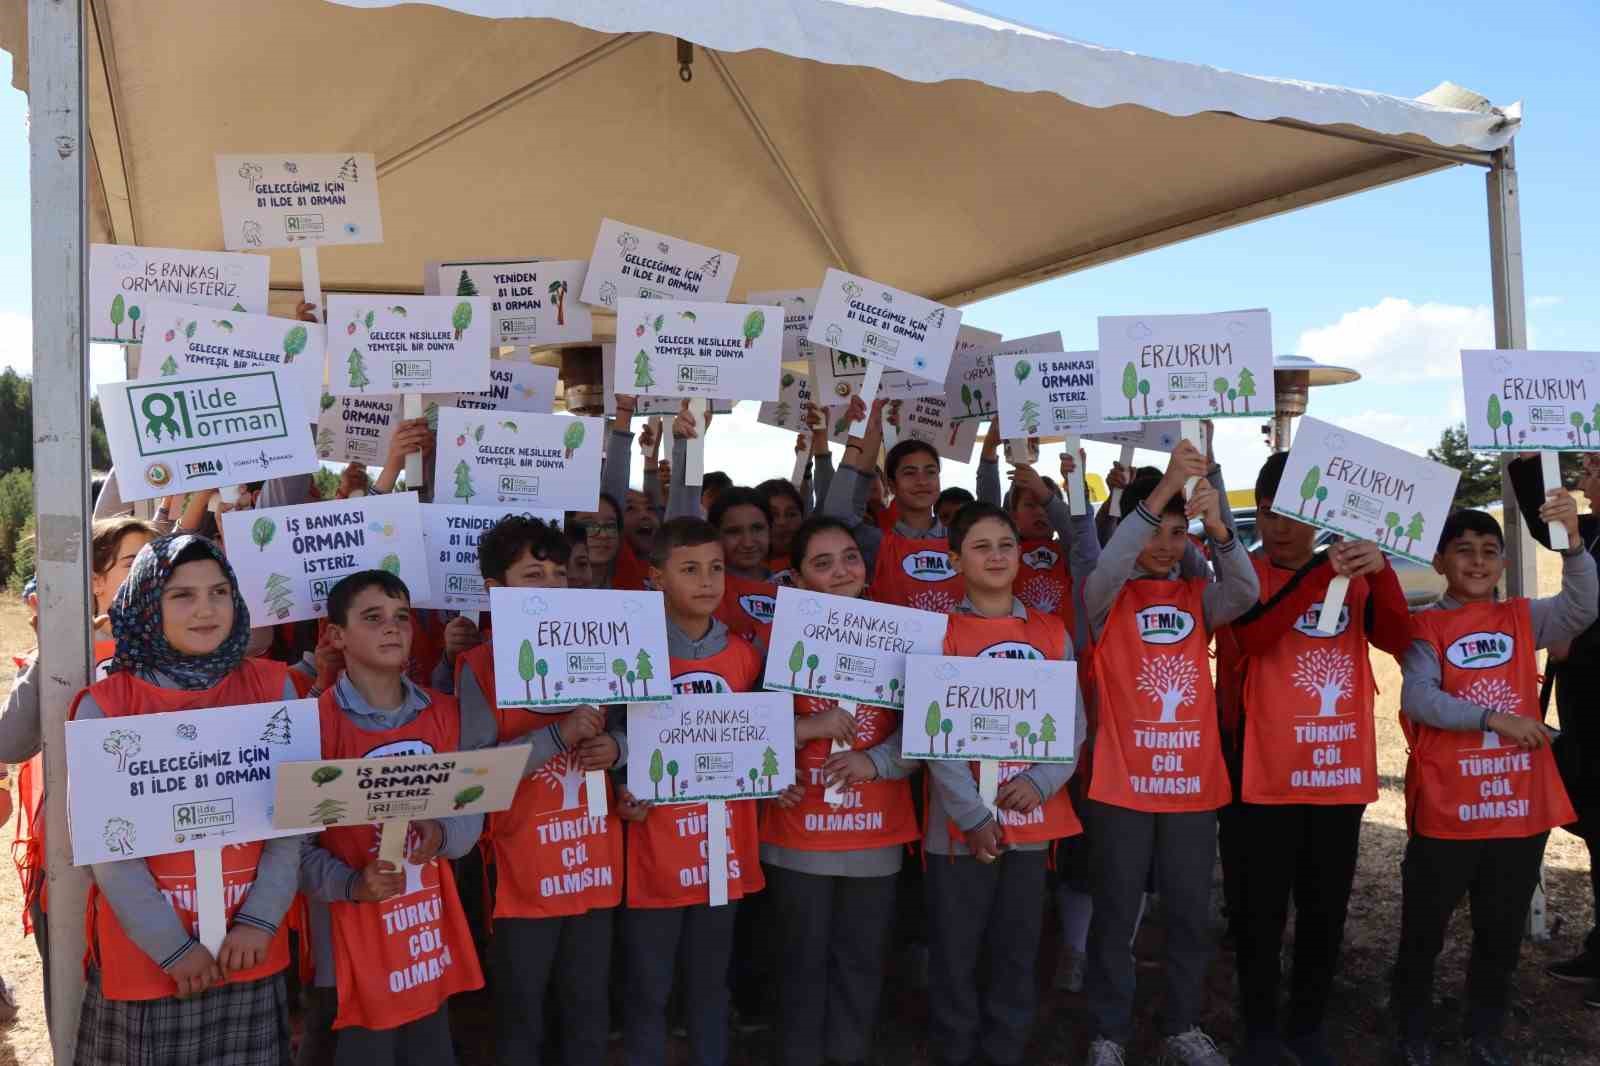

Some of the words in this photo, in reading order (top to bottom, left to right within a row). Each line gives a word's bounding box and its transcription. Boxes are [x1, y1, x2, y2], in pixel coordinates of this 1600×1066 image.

[257, 197, 267, 208] 81
[297, 196, 307, 206] 81
[310, 195, 346, 206] ORMAN
[161, 262, 219, 280] BANKASI
[621, 264, 631, 275] 81
[656, 274, 665, 284] 81
[667, 278, 700, 293] ORMAN
[121, 277, 183, 294] ORMANI
[498, 287, 508, 298] 81
[492, 302, 502, 311] 81
[505, 299, 542, 311] ORMAN
[847, 309, 856, 319] 81
[881, 321, 890, 331] 81
[893, 325, 925, 342] ORMAN
[369, 331, 406, 340] GELECEK
[657, 335, 695, 345] GELECEK
[188, 342, 229, 356] GELECEK
[1141, 342, 1233, 369] ERZURUM
[1051, 360, 1095, 372] BANKASI
[1041, 373, 1094, 389] ORMANI
[1503, 377, 1587, 401] ERZURUM
[190, 388, 237, 411] ilde
[354, 399, 393, 411] BANKASI
[197, 413, 278, 437] orman
[342, 409, 390, 426] ORMANI
[478, 445, 516, 456] GELECEK
[185, 460, 215, 475] TEMA
[1326, 456, 1416, 505] ERZURUM
[286, 515, 300, 536] İŞ
[305, 510, 365, 531] BANKASI
[292, 529, 365, 555] ORMANI
[449, 534, 461, 546] 81
[465, 533, 482, 547] İL
[440, 550, 451, 562] 81
[913, 556, 945, 569] TEMA
[747, 599, 776, 614] TEM
[537, 620, 630, 647] ERZURUM
[843, 612, 899, 636] BANKASI
[803, 623, 863, 647] ORMANI
[673, 679, 713, 695] TEMA
[944, 685, 1036, 711] ERZURUM
[696, 709, 750, 726] BANKASI
[659, 727, 717, 745] ORMANI
[1134, 726, 1200, 750] TÜRKİYE
[1294, 722, 1357, 744] TÜRKİYE
[128, 749, 232, 776] GELECEĞİMİZ
[239, 744, 270, 768] İÇİN
[1152, 751, 1184, 775] ÇÖL
[1312, 744, 1342, 767] ÇÖL
[1458, 751, 1532, 777] TÜRKİYE
[381, 760, 456, 776] BANKASI
[1290, 767, 1362, 788] OLMASIN
[130, 780, 145, 797] 81
[151, 776, 187, 794] İLDE
[195, 773, 209, 789] 81
[215, 766, 271, 786] ORMAN
[358, 772, 450, 790] ORMANI
[1480, 775, 1514, 801] ÇÖL
[804, 811, 883, 833] OLMASIN
